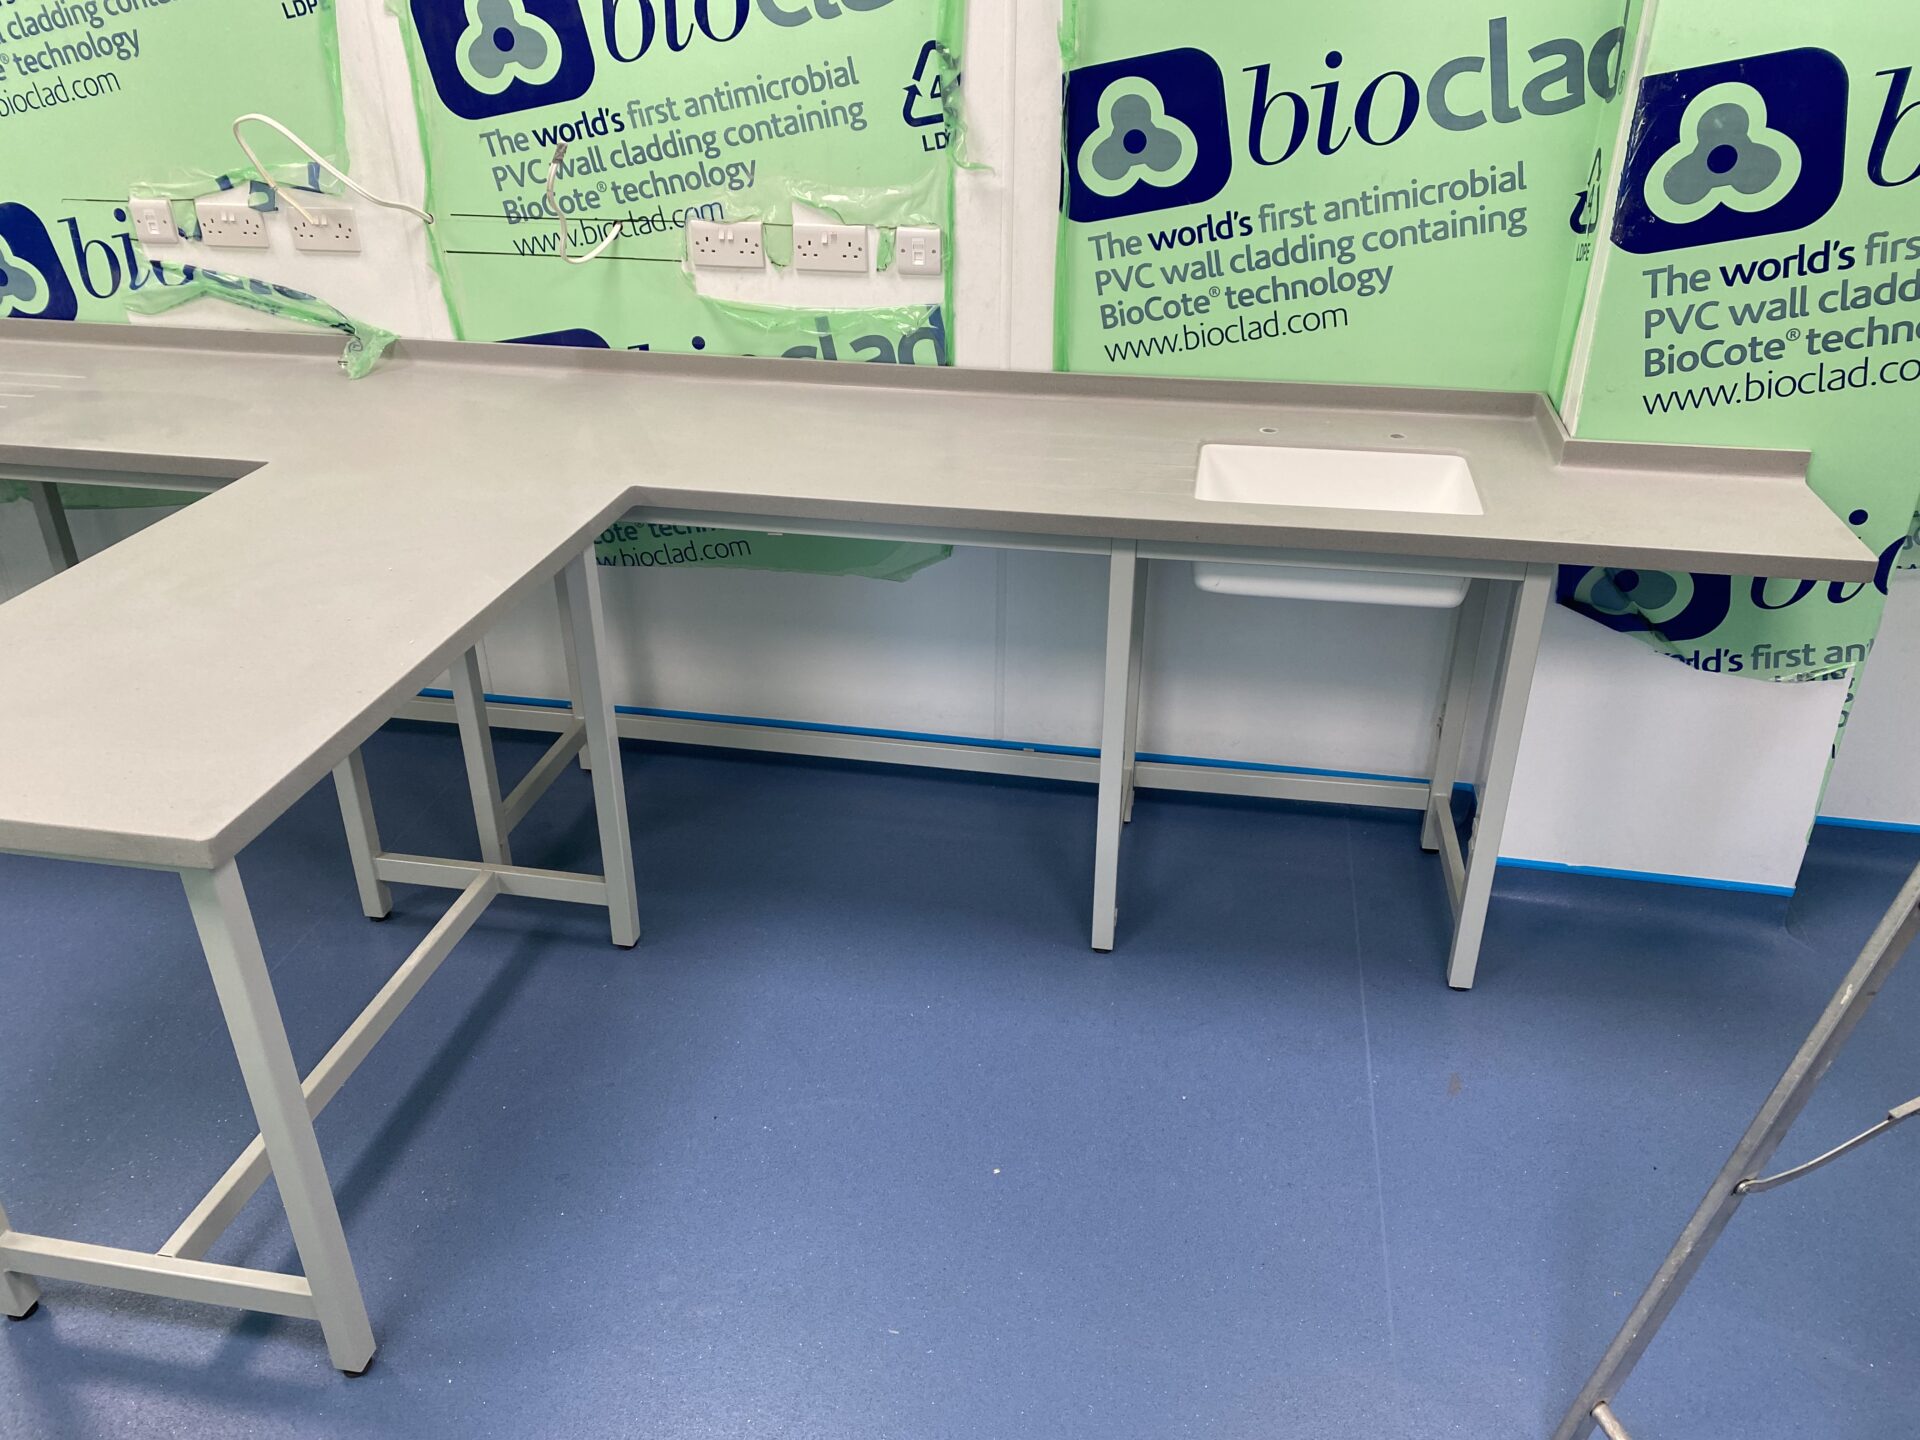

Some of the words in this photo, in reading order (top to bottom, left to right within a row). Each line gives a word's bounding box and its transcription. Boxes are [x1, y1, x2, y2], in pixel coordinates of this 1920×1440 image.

[7, 0, 104, 40] cladding
[12, 29, 140, 76] technology
[479, 128, 530, 157] The
[532, 107, 625, 147] world's
[626, 97, 680, 129] first
[684, 55, 860, 118] antimicrobial
[492, 158, 547, 192] PVC
[549, 145, 607, 180] wall
[610, 128, 721, 169] cladding
[723, 99, 868, 147] containing
[611, 159, 756, 205] technology
[1088, 231, 1142, 261] The
[1147, 210, 1253, 251] world's
[1258, 201, 1317, 233] first
[1324, 160, 1527, 222] antimicrobial
[1095, 263, 1155, 296] PVC
[1160, 249, 1224, 285] wall
[1230, 233, 1356, 274] cladding
[1362, 204, 1528, 251] containing
[1642, 264, 1711, 298] The
[1719, 240, 1855, 287] world's
[1224, 265, 1394, 310] technology
[1644, 300, 1720, 339] PVC
[1728, 285, 1810, 326] wall
[1104, 308, 1348, 362] www.bioclad.com
[1751, 643, 1816, 670] first
